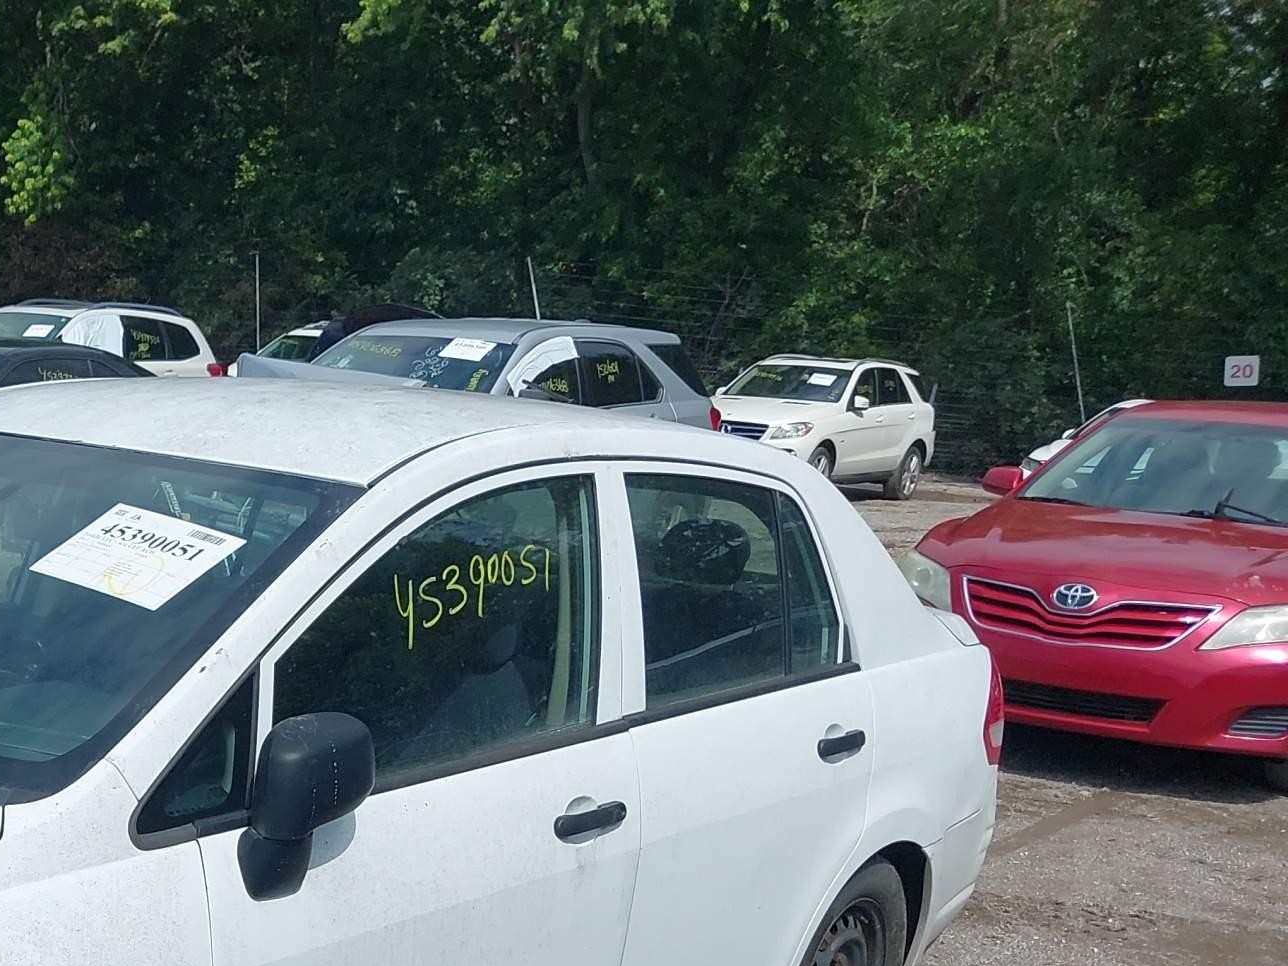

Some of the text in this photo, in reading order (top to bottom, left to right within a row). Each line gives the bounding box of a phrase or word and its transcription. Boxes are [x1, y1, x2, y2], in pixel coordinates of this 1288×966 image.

[1230, 364, 1253, 379] 20
[100, 523, 205, 561] 45390051
[394, 544, 549, 650] 45390051
